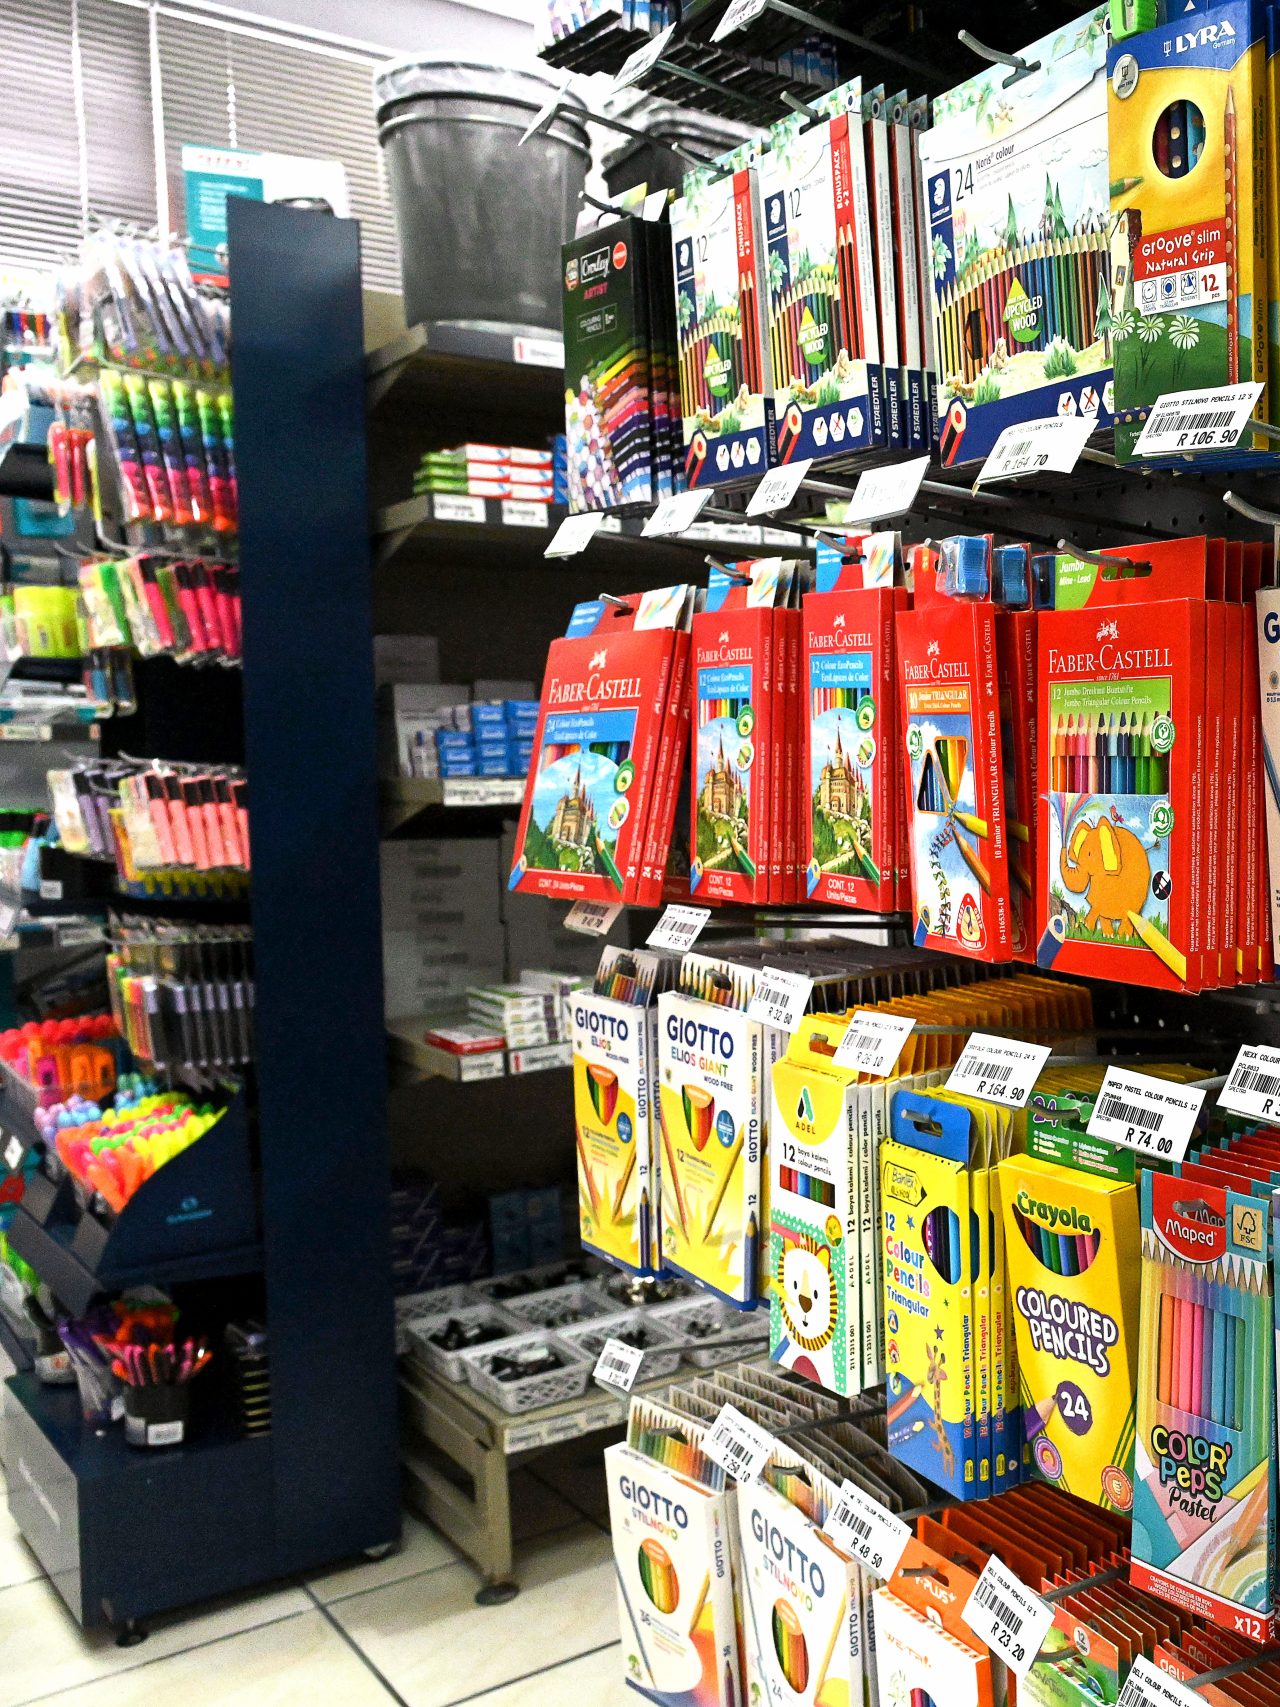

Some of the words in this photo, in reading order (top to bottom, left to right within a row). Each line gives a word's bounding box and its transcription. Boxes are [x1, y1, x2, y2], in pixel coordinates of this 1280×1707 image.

[1174, 20, 1236, 54] LYRA
[1212, 38, 1236, 50] Germany
[834, 150, 842, 209] BONUSPACK
[955, 163, 974, 201] 24
[789, 188, 802, 219] 12
[1197, 229, 1221, 244] slim
[1146, 253, 1187, 274] Natural
[1193, 249, 1215, 264] Grip
[1202, 274, 1219, 292] 12
[1005, 296, 1042, 318] UPCYCLED
[1013, 312, 1036, 331] WOOD
[873, 376, 881, 427] STAEDTLER
[1177, 434, 1188, 446] R
[1190, 429, 1238, 445] 106.90
[809, 630, 873, 648] FABER-CASTELL
[697, 645, 753, 663] FABER-CASTELL
[1049, 645, 1173, 673] FABER-CASTELL
[904, 658, 970, 680] FABER-CASTELL
[549, 675, 642, 705] FABER-CASTELL
[995, 846, 1002, 859] 10
[575, 1007, 629, 1041] GIOTTO
[667, 1014, 734, 1059] GIOTTO
[591, 1035, 612, 1051] ELIOS
[671, 1046, 695, 1066] ELIOS
[699, 1056, 728, 1077] GIANT
[977, 1081, 986, 1092] R
[987, 1083, 1024, 1100] 164.90
[1108, 1081, 1122, 1089] MAPED
[1124, 1085, 1141, 1096] PASTEL
[1145, 1091, 1163, 1101] COLOUR
[1165, 1097, 1188, 1108] PENCILS
[1262, 1099, 1273, 1114] R
[795, 1121, 815, 1134] ADEL
[1125, 1128, 1134, 1142] R
[1138, 1131, 1172, 1154] 74.00
[783, 1143, 795, 1162] 12
[885, 1211, 896, 1231] 12
[1017, 1191, 1093, 1233] Crayola
[1165, 1218, 1215, 1248] Maped
[1239, 1234, 1256, 1245] FSC
[886, 1236, 925, 1270] Colour
[886, 1265, 931, 1299] Pencils
[887, 1286, 930, 1318] Triangular
[1017, 1289, 1117, 1345] COLOURED
[1029, 1319, 1109, 1375] PENCILS
[1060, 1391, 1089, 1421] 24
[619, 1475, 688, 1529] GIOTTO
[1168, 1486, 1217, 1523] Pastel
[751, 1509, 825, 1598] GIOTTO
[991, 1622, 999, 1636] R
[998, 1630, 1025, 1661] 23.20
[1234, 1616, 1261, 1641] x12
[1160, 1659, 1184, 1681] deli
